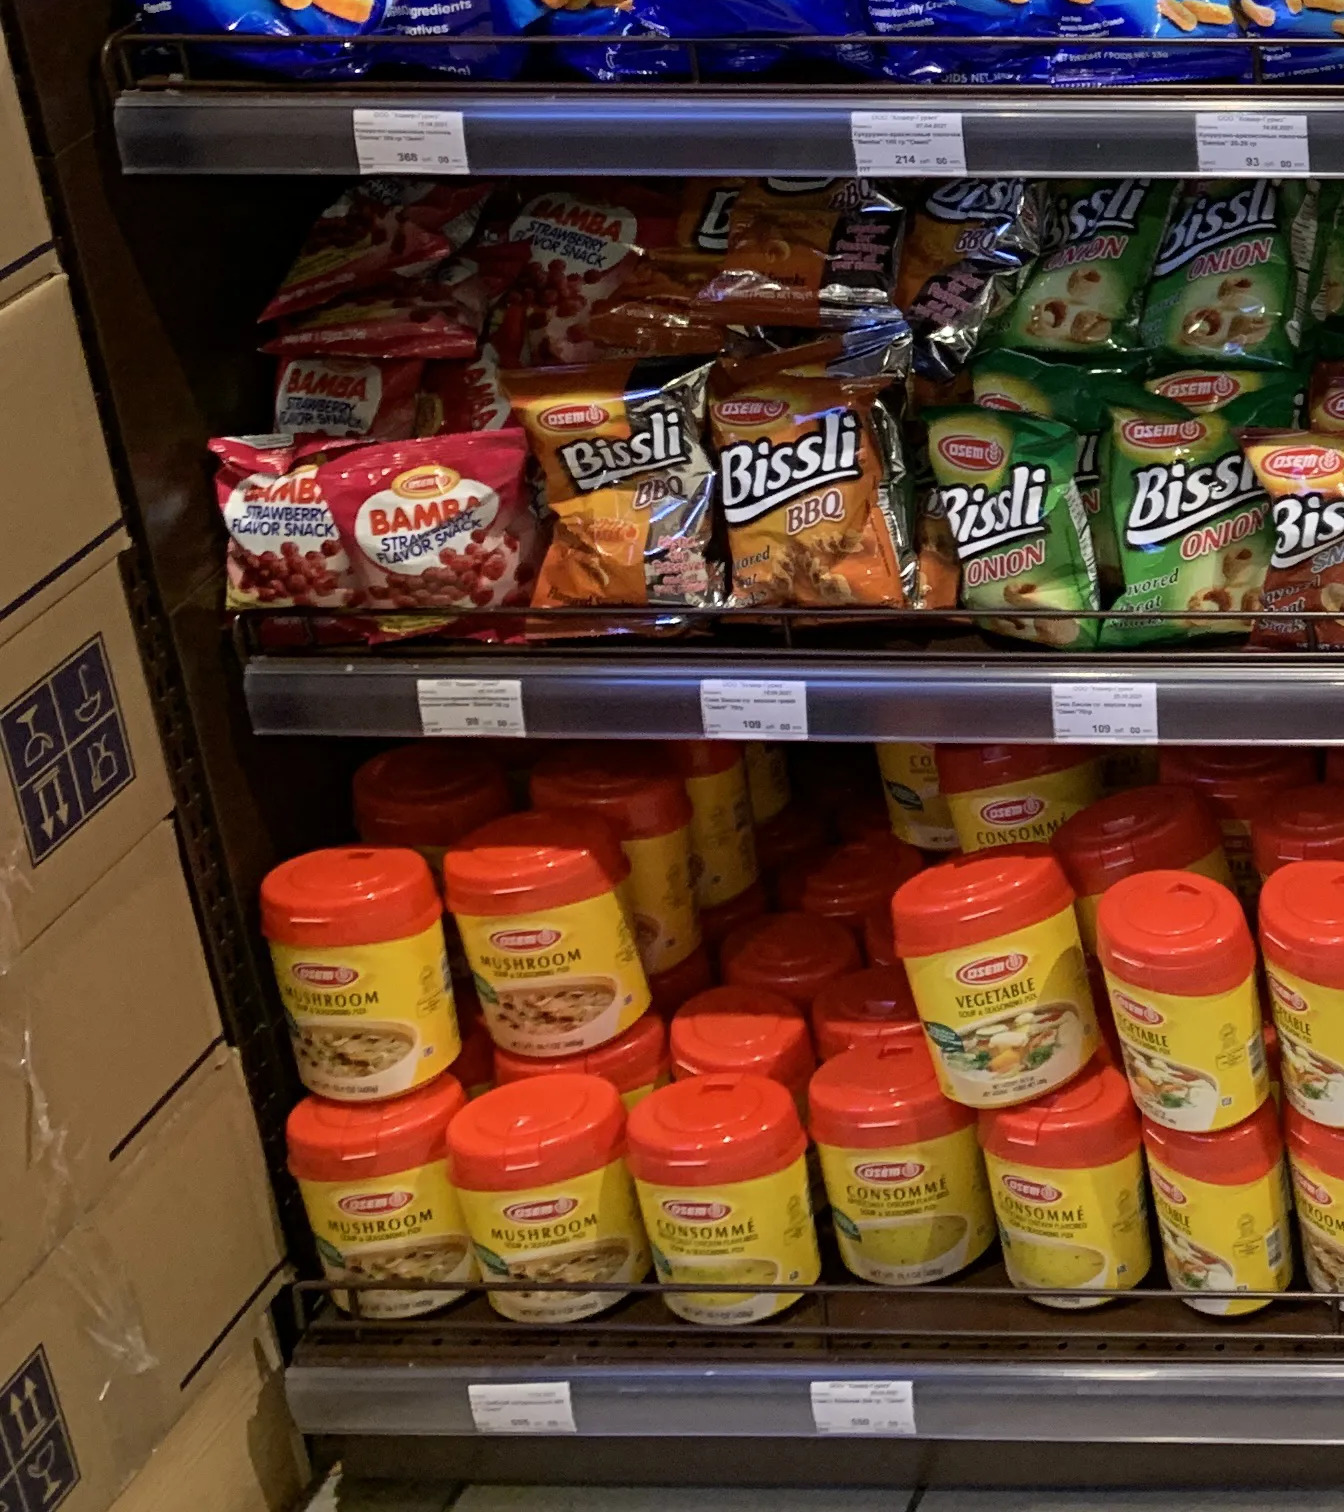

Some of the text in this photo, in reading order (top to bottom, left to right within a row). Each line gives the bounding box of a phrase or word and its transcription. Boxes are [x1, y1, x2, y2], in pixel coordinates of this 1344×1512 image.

[895, 155, 915, 164] 214
[1246, 157, 1260, 166] 93
[721, 411, 857, 507] Bissli
[242, 503, 329, 522] STRAWBERRY
[785, 488, 845, 535] BBQ
[232, 519, 337, 538] FLAVOR SNACK
[967, 540, 1045, 585] ONION
[480, 948, 582, 970] MUSHROOM
[955, 977, 1036, 1010] VEGETABLE
[845, 1175, 948, 1202] CONSOMMÉ
